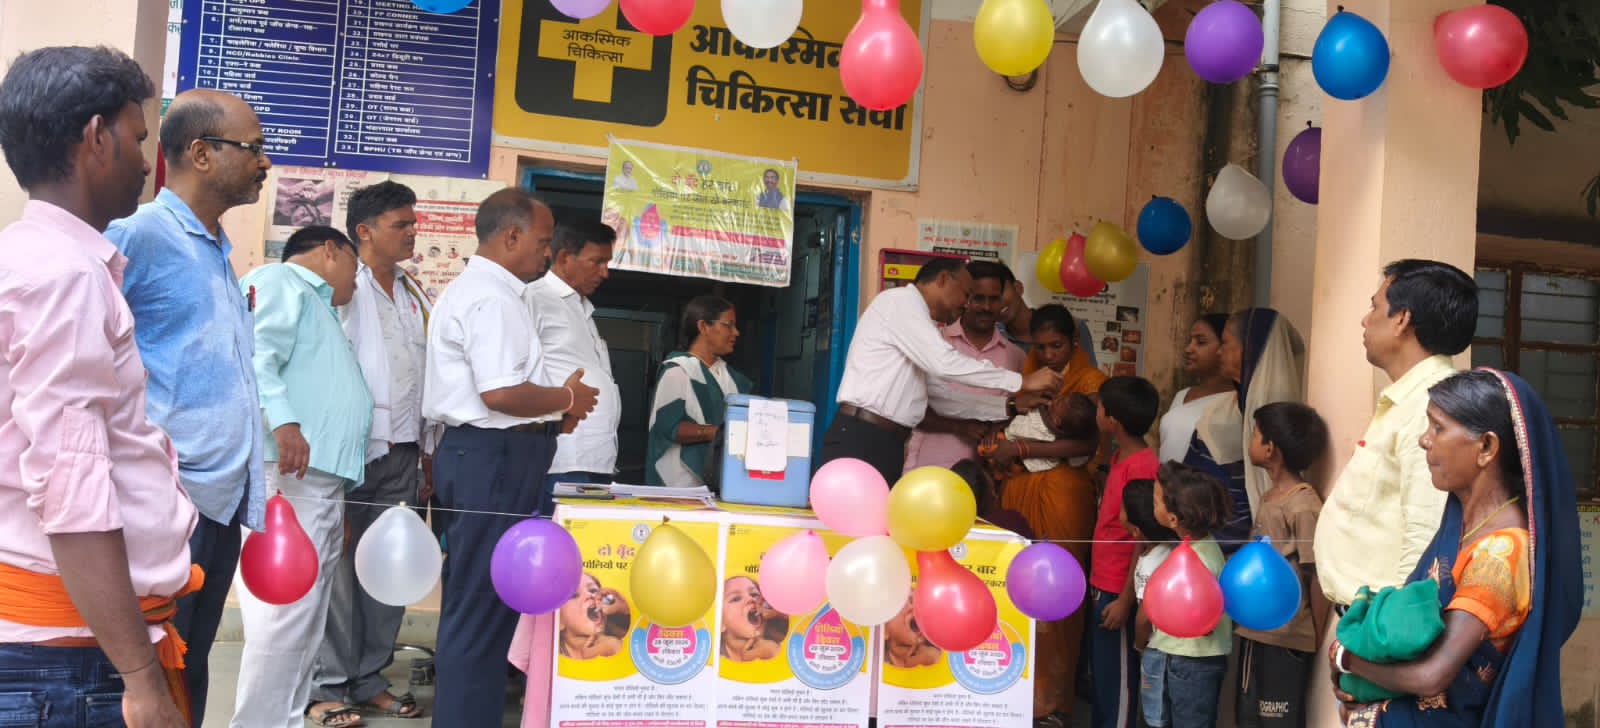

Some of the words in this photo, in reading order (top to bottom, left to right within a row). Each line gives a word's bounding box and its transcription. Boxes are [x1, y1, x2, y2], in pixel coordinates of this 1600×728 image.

[386, 12, 419, 20] CORNER
[563, 29, 632, 47] आकस्मिक
[568, 42, 624, 63] चिकित्सा
[686, 65, 833, 122] चिकित्सा
[367, 103, 378, 111] OT
[839, 95, 908, 130] सवा
